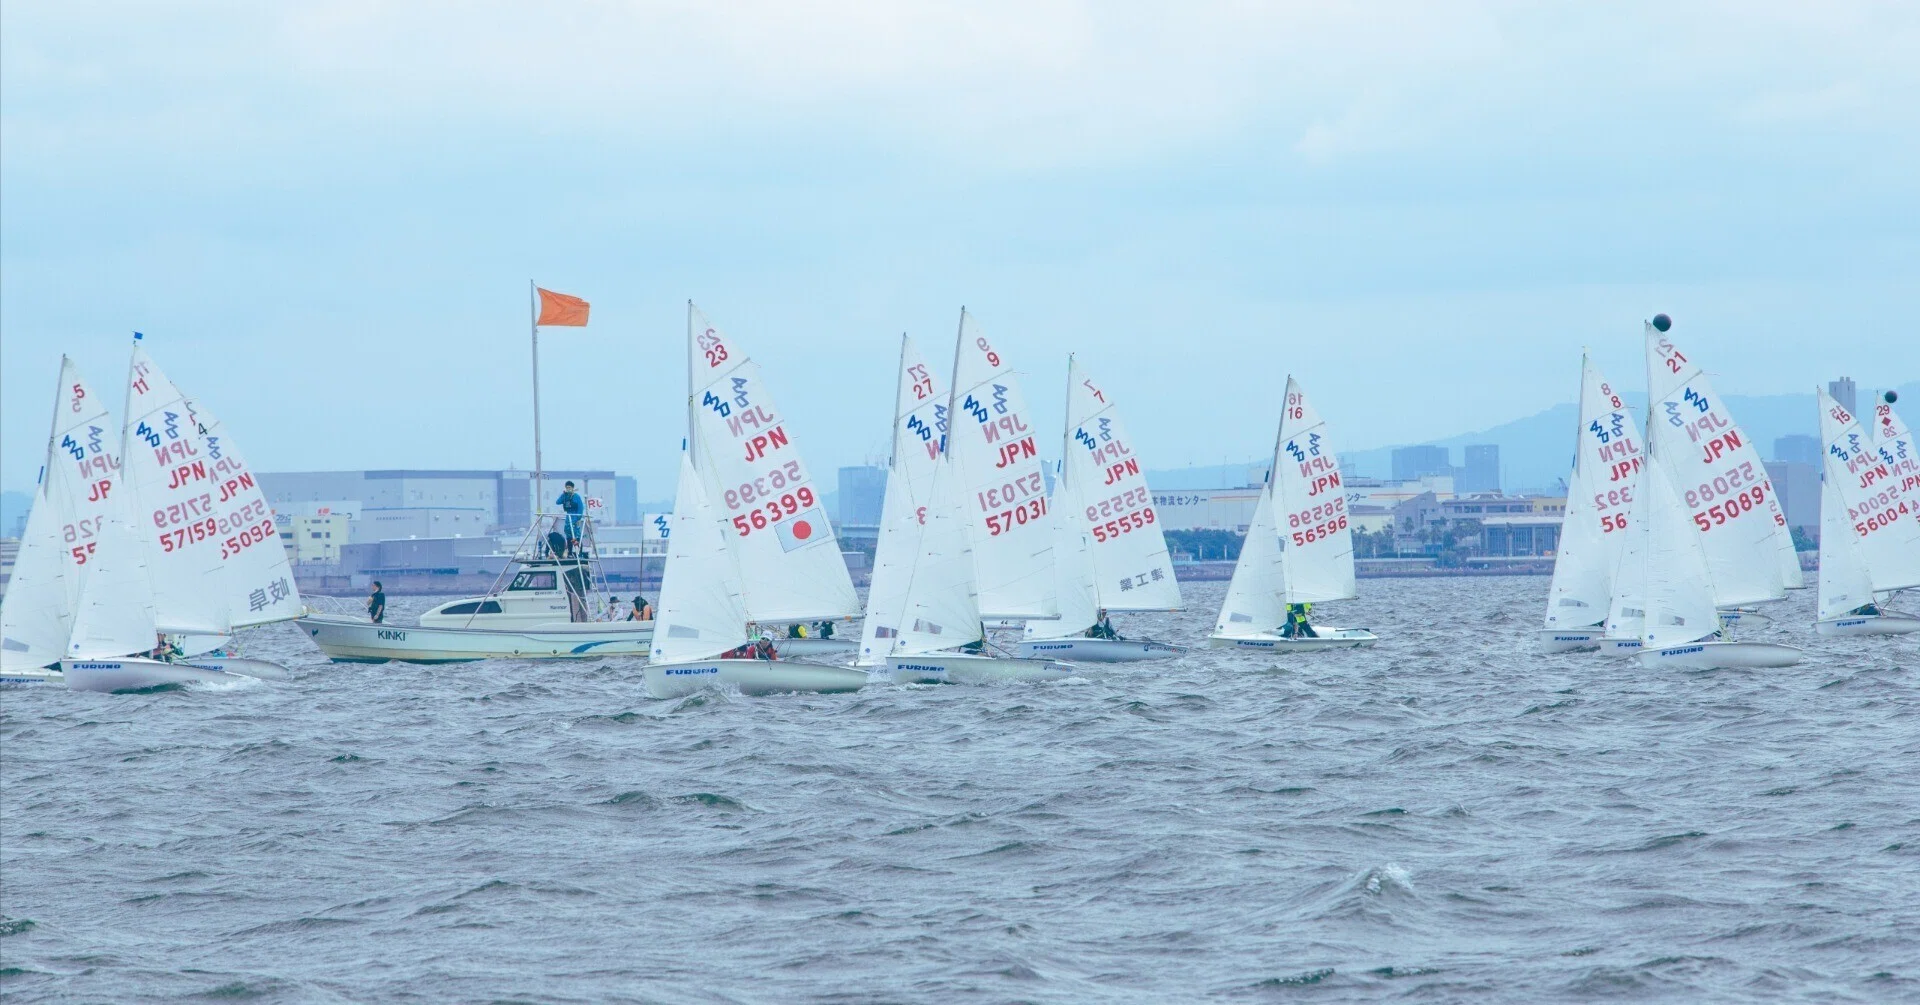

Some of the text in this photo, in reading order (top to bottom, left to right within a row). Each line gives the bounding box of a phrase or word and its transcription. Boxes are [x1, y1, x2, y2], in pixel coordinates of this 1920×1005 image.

[705, 344, 728, 368] 23
[986, 351, 1000, 367] 9
[1667, 351, 1687, 373] 21
[73, 384, 85, 399] 5
[132, 377, 150, 395] 11
[913, 378, 933, 400] 27
[1093, 390, 1105, 403] 7
[703, 391, 730, 418] 420
[963, 394, 988, 423] 420
[1611, 395, 1621, 408] 8
[1684, 387, 1709, 413] 420
[1876, 404, 1890, 416] 29
[1287, 406, 1303, 420] 16
[1836, 411, 1850, 425] 15
[136, 421, 160, 448] 420
[907, 414, 931, 441] 420
[1075, 427, 1096, 450] 420
[1590, 420, 1609, 443] 420
[61, 434, 84, 460] 420
[744, 425, 789, 462] JPN
[995, 436, 1036, 468] JPN
[1286, 440, 1305, 462] 420
[1703, 430, 1742, 463] JPN
[1830, 444, 1849, 461] 420
[1879, 447, 1894, 464] 420
[168, 460, 206, 490] JPN
[1104, 458, 1139, 485] JPN
[1860, 464, 1888, 488] JPN
[87, 479, 112, 502] JP
[219, 472, 254, 503] JPN
[1308, 472, 1340, 496] JPN
[732, 487, 814, 537] 56399
[985, 496, 1046, 536] 57031
[1693, 486, 1764, 532] 55089
[1855, 501, 1908, 536] 56004
[159, 517, 217, 553] 57159
[653, 515, 670, 538] 420
[1092, 507, 1155, 543] 55559
[1292, 515, 1347, 547] 56596
[377, 630, 406, 642] KINKI
[1662, 646, 1704, 656] FURUNO
[666, 667, 718, 675] FURUNO
[897, 664, 945, 672] FURUNO
